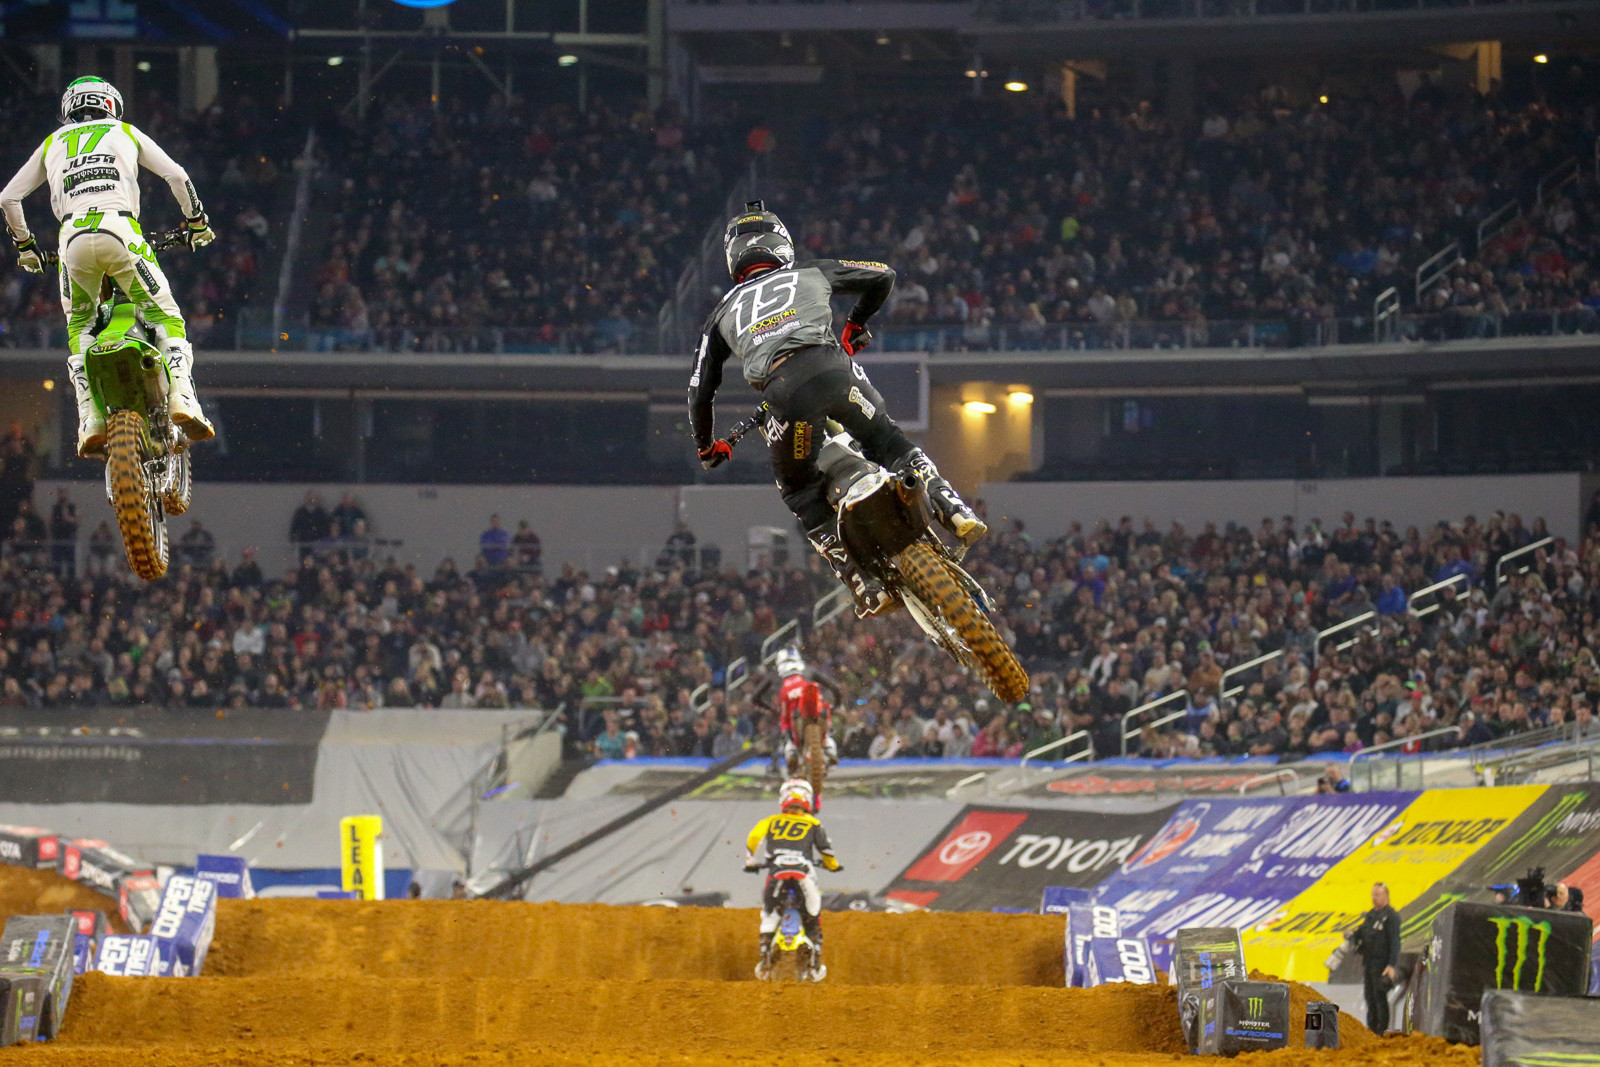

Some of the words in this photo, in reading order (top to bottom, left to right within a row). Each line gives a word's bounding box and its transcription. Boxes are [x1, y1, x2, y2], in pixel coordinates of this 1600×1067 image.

[62, 127, 110, 160] 17
[73, 167, 117, 180] MONSTER
[69, 183, 115, 199] Kawasaki
[762, 320, 802, 341] Husqvarna
[770, 818, 813, 841] 46
[998, 833, 1143, 874] TOYOTA
[151, 875, 194, 939] COOPER
[187, 879, 213, 914] TIRES
[1225, 1029, 1283, 1039] SUPERCROSS
[1239, 1020, 1270, 1028] MONSTER
